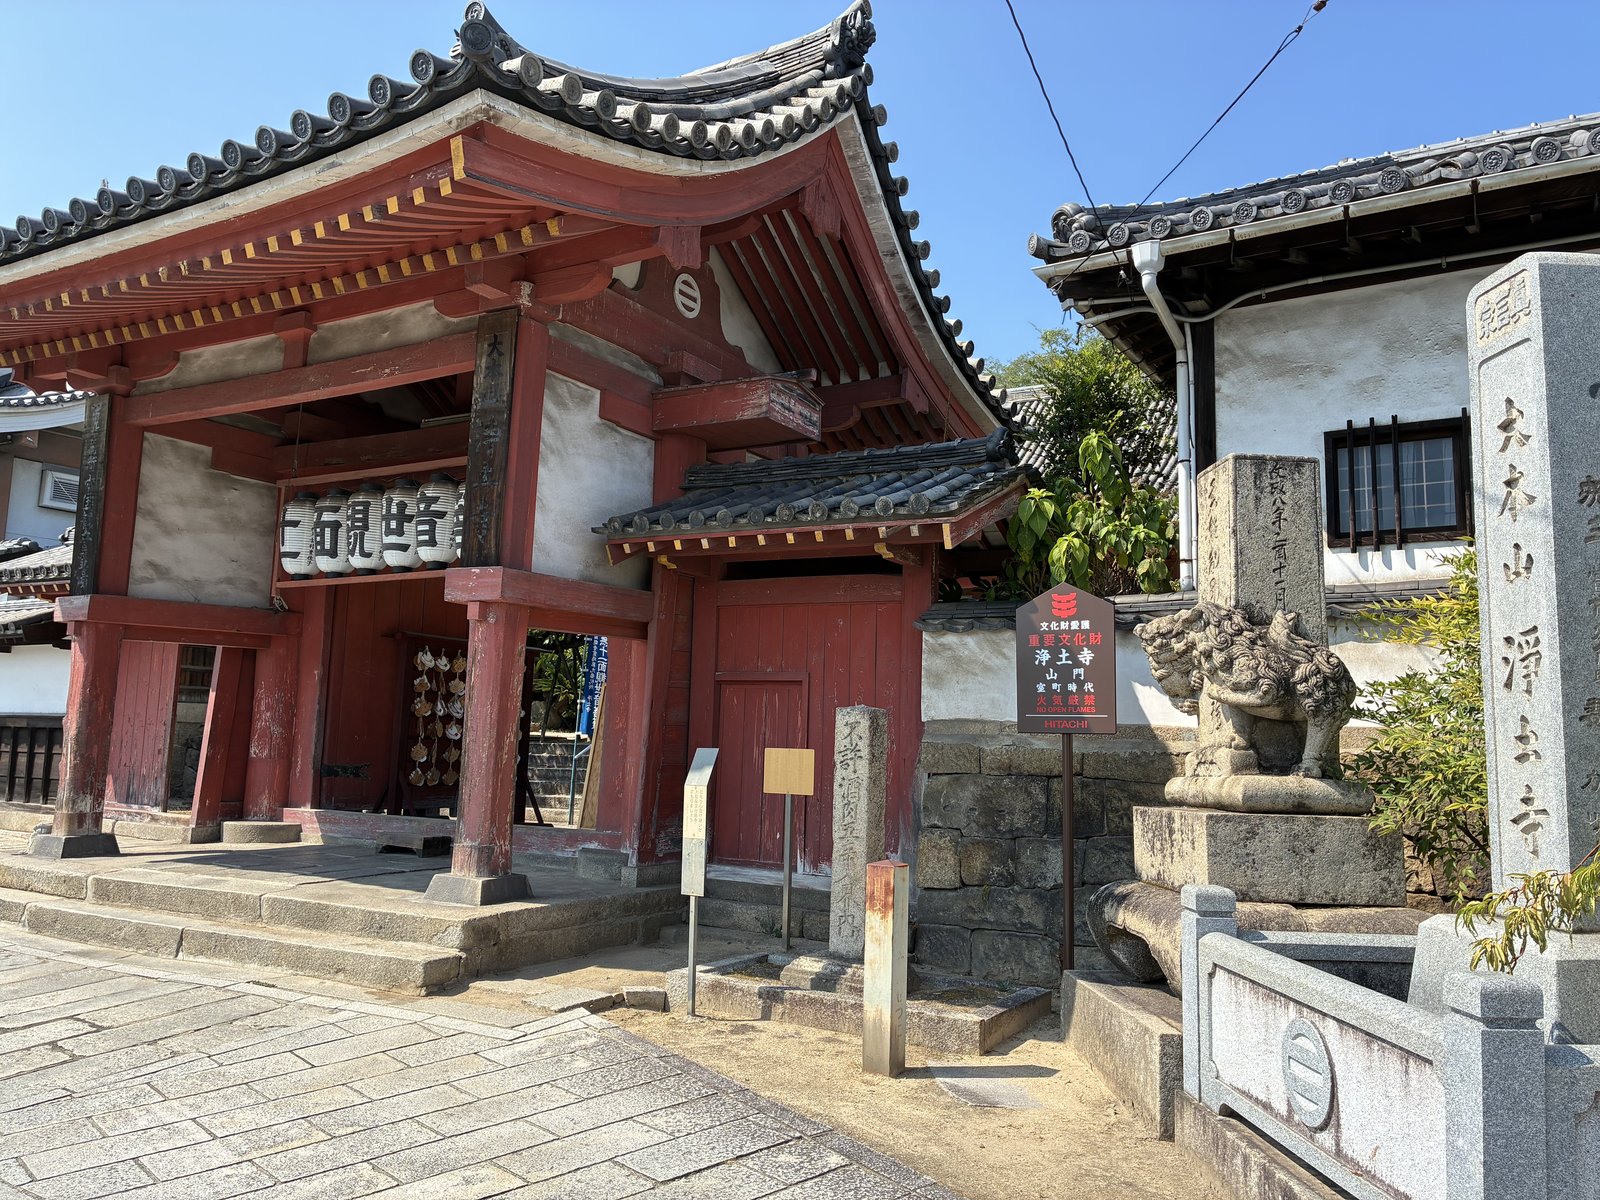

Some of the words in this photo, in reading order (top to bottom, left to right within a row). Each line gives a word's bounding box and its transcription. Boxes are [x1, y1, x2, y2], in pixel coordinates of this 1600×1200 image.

[1040, 620, 1090, 631] 文化財愛護
[1028, 632, 1102, 647] 重要文化財
[1034, 647, 1095, 666] 浄土寺
[1045, 667, 1084, 680] 山門
[1035, 682, 1095, 693] 室町時代
[1036, 694, 1096, 706] 火気厳禁
[1044, 720, 1088, 729] HITACHI
